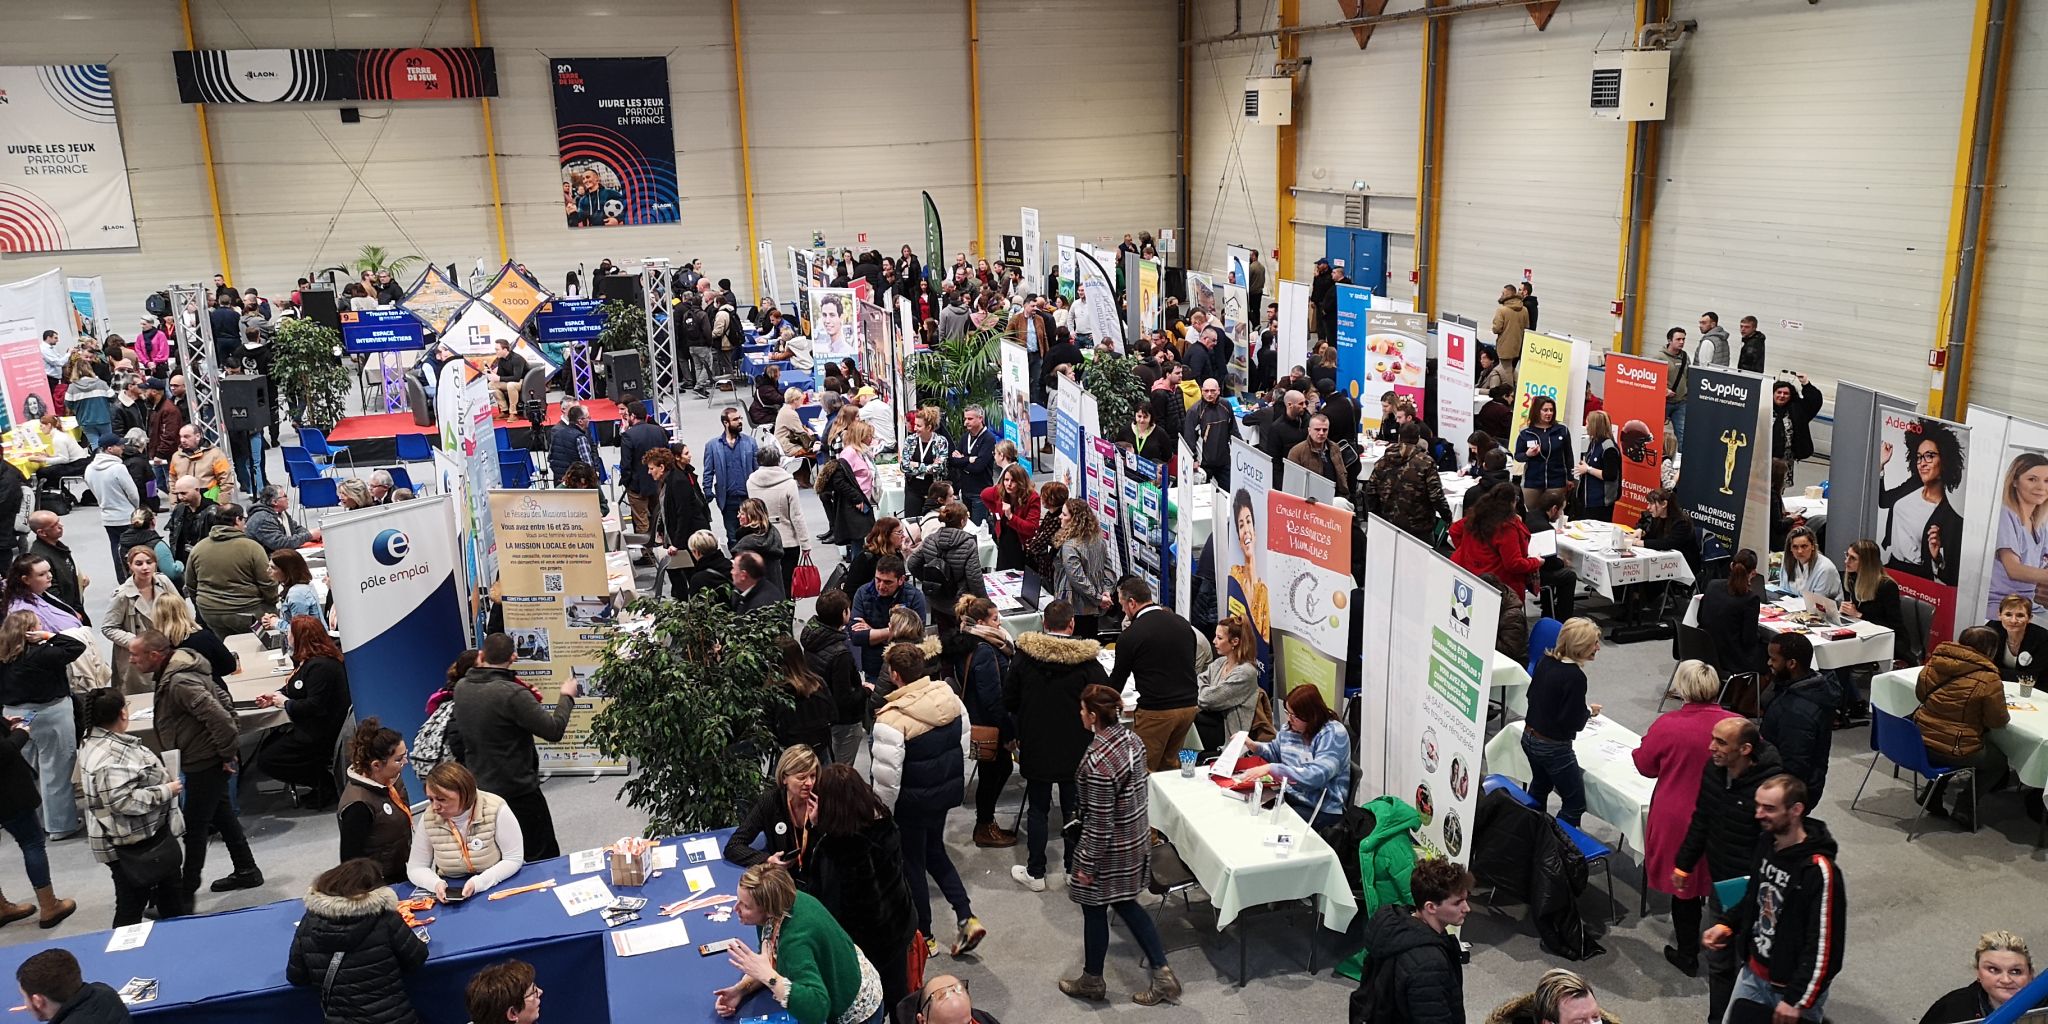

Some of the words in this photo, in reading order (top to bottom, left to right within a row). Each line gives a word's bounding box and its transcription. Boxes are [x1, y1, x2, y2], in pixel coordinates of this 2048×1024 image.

[405, 57, 423, 67] 20
[406, 66, 432, 74] TERRE
[557, 64, 572, 73] 20
[407, 73, 418, 81] DE
[419, 73, 438, 81] JEUX
[424, 80, 439, 90] 24
[572, 84, 585, 93] 24
[598, 99, 625, 108] VIVRE
[627, 98, 642, 107] LES
[643, 97, 664, 106] JEUX
[625, 106, 664, 116] PARTOUT
[617, 116, 629, 126] EN
[631, 115, 666, 125] FRANCE
[7, 144, 42, 155] VIVRE
[46, 143, 65, 153] LES
[68, 143, 96, 153] JEUX
[28, 154, 81, 165] PARTOUT
[24, 165, 40, 175] EN
[43, 164, 89, 175] FRANCE
[343, 313, 349, 321] 9
[1529, 342, 1563, 364] Supplay
[1616, 363, 1658, 384] Supplay
[1525, 382, 1558, 402] 1968
[1700, 378, 1748, 401] Supplay
[1885, 415, 1923, 435] Adecco
[1255, 469, 1264, 483] EP
[1622, 489, 1630, 498] LE
[503, 510, 511, 518] Le
[531, 509, 541, 518] des
[542, 509, 567, 518] Missions
[567, 509, 588, 518] Locales
[1697, 503, 1737, 522] VALORISONS
[1309, 513, 1342, 533] Formation
[1681, 507, 1690, 517] ES
[1690, 511, 1735, 531] COMPÉTENCES
[500, 523, 515, 531] Vous
[530, 523, 546, 531] entre
[555, 523, 562, 531] et
[562, 523, 570, 531] 25
[1286, 519, 1332, 546] Ressources
[1289, 535, 1329, 560] Humaines
[1660, 562, 1678, 570] LAON
[360, 574, 386, 594] pôle
[389, 561, 429, 583] emploi
